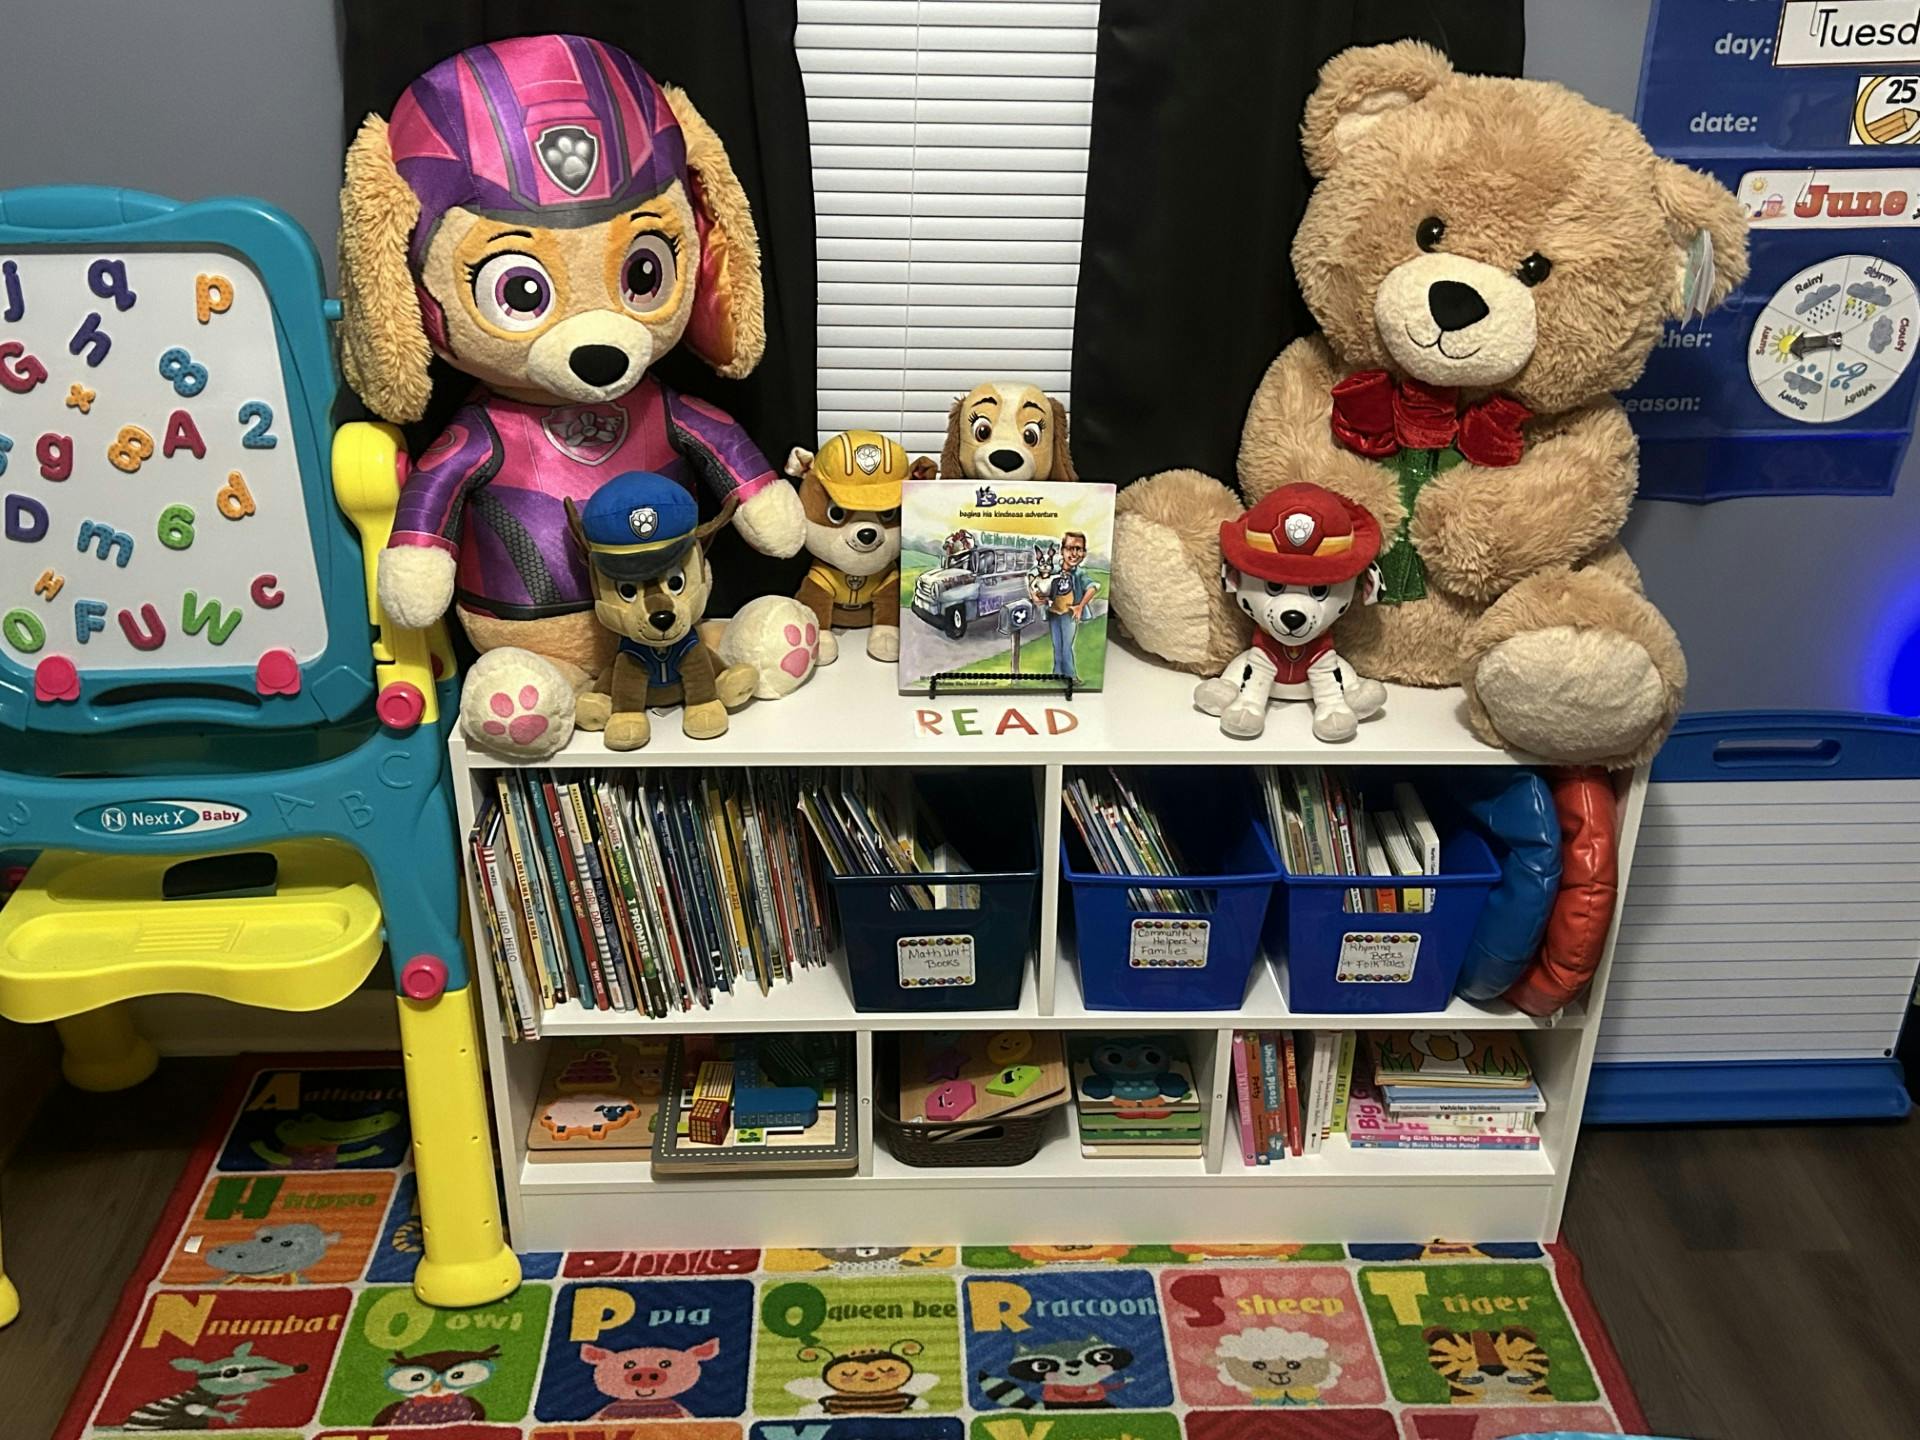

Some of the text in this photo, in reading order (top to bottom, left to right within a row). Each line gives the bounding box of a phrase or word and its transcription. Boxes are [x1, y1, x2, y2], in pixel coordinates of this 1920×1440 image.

[1714, 33, 1771, 61] day:
[1690, 79, 1918, 134] date: 25
[1794, 184, 1908, 219] June
[1795, 273, 1824, 294] Rainy
[1657, 329, 1713, 348] ther:
[1756, 326, 1773, 356] Sunny
[1894, 317, 1910, 352] Cloudy
[0, 342, 48, 393] G
[159, 348, 208, 396] 8
[1624, 397, 1701, 413] eason:
[1778, 389, 1808, 411] Snowy
[1844, 383, 1877, 406] Windy
[163, 410, 206, 459] A
[239, 402, 277, 449] 2
[36, 433, 73, 482] g
[107, 425, 154, 473] 8
[6, 496, 49, 542] D
[158, 505, 195, 550] 6
[994, 510, 1024, 518] kindness
[1025, 510, 1058, 518] adventure
[78, 521, 134, 567] m
[75, 600, 107, 643] F
[914, 708, 1079, 737] READ
[132, 812, 169, 826] Next
[202, 811, 240, 823] Baby
[513, 852, 526, 875] LLAMA
[518, 875, 530, 897] LLAMA
[524, 898, 534, 920] MISSES
[585, 888, 603, 929] GIRL DAD
[498, 910, 518, 962] HELLO HELLO
[529, 920, 539, 940] MAMA
[629, 907, 651, 959] PROMISE
[1138, 928, 1192, 940] Community
[1153, 937, 1188, 948] Helpers
[908, 948, 942, 960] Math
[924, 959, 960, 969] Books
[1141, 946, 1188, 956] Families
[303, 1086, 405, 1102] alligat
[1358, 1104, 1381, 1130] Big
[1459, 1135, 1480, 1143] Potty!
[203, 1176, 378, 1221] H hippo
[761, 1281, 958, 1347] Q queen bee
[965, 1280, 1160, 1335] R raccoon
[1169, 1273, 1345, 1328] S sheep
[1367, 1270, 1533, 1327] T tiger
[140, 1294, 344, 1350] N numbat
[445, 1309, 524, 1333] owl
[569, 1286, 714, 1344] P pig
